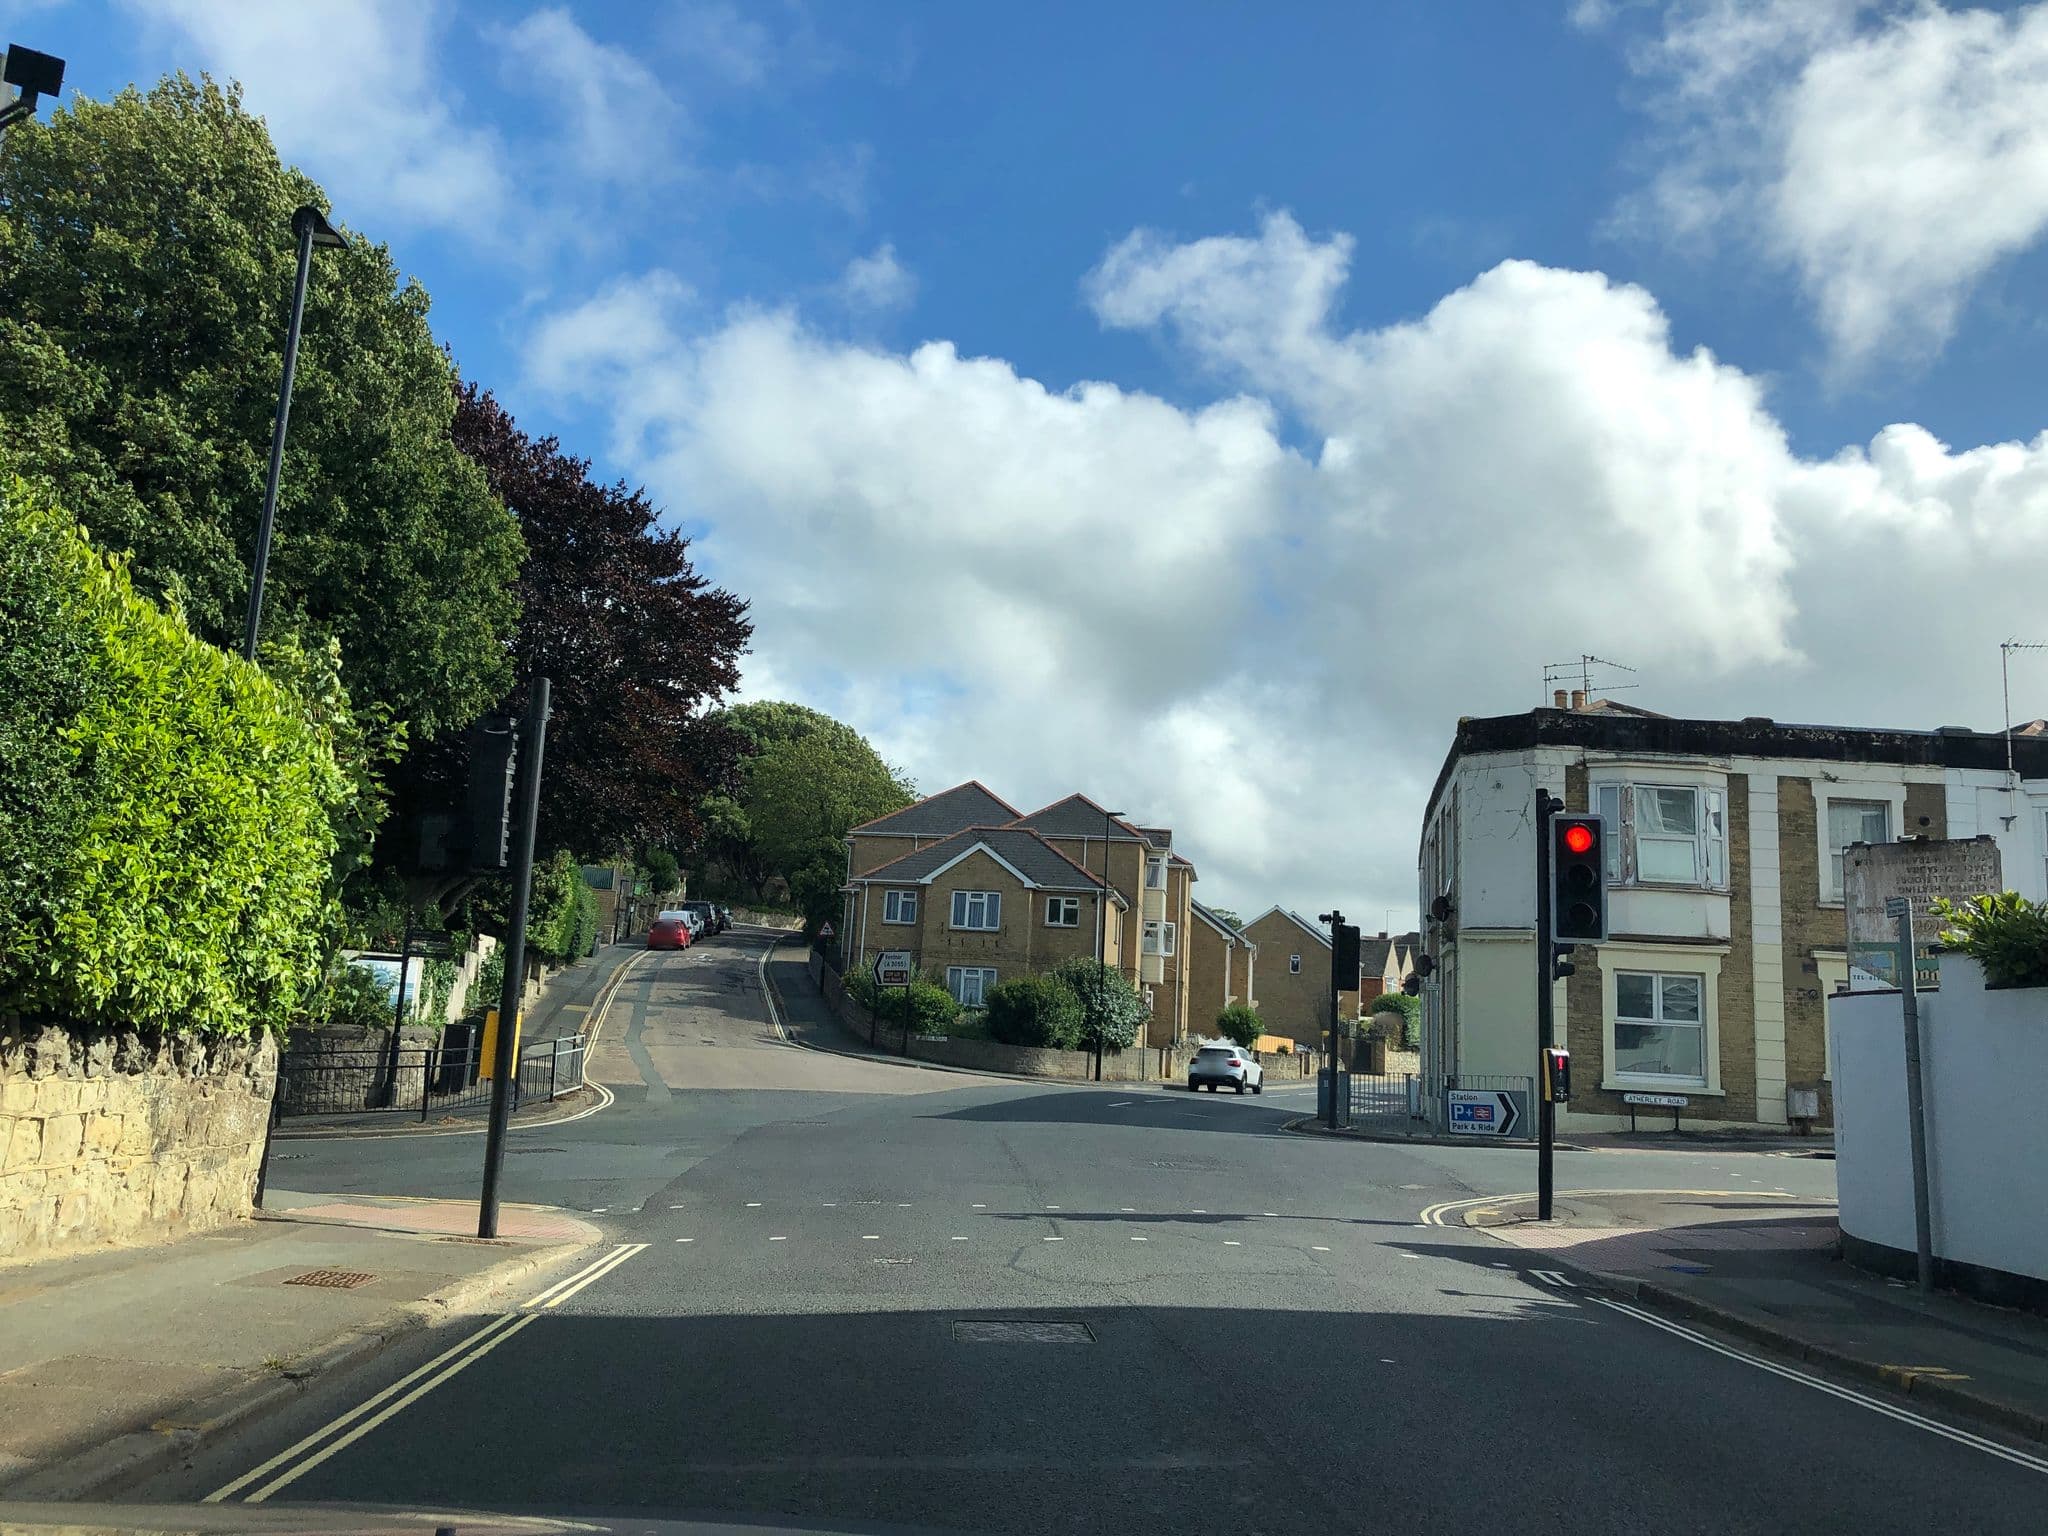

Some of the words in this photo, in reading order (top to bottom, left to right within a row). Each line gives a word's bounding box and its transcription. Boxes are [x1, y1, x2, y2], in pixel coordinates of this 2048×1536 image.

[1451, 1093, 1478, 1101] Station
[1628, 1095, 1662, 1104] ATHERLEY
[1667, 1097, 1685, 1105] ROAD
[1452, 1122, 1469, 1131] Park
